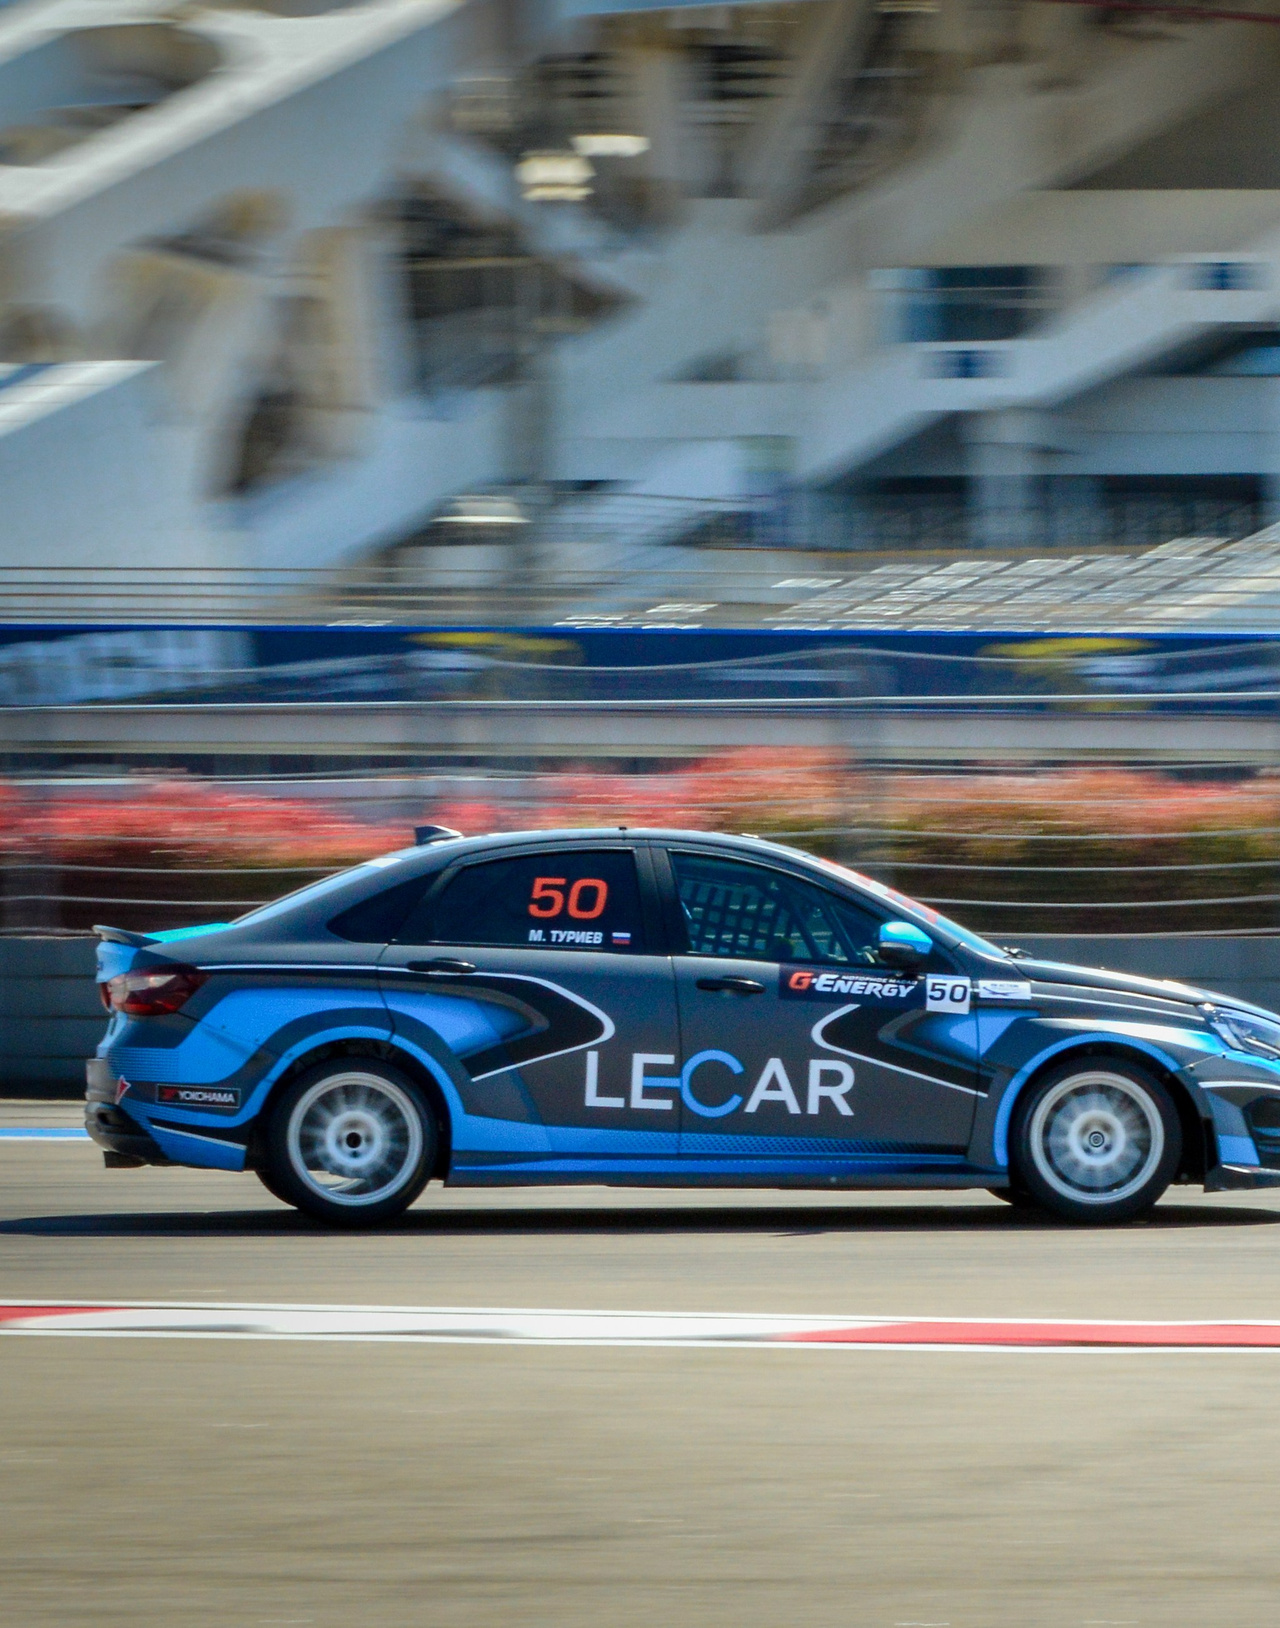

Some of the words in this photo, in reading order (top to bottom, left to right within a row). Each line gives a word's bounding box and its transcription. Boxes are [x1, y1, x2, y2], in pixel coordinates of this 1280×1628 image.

[527, 877, 608, 919] 50
[528, 929, 547, 942] М.
[550, 930, 604, 944] ТУРИЕВ
[928, 982, 968, 1003] 50
[584, 1049, 855, 1117] LECAR
[178, 1090, 235, 1103] YOKOHAMA
